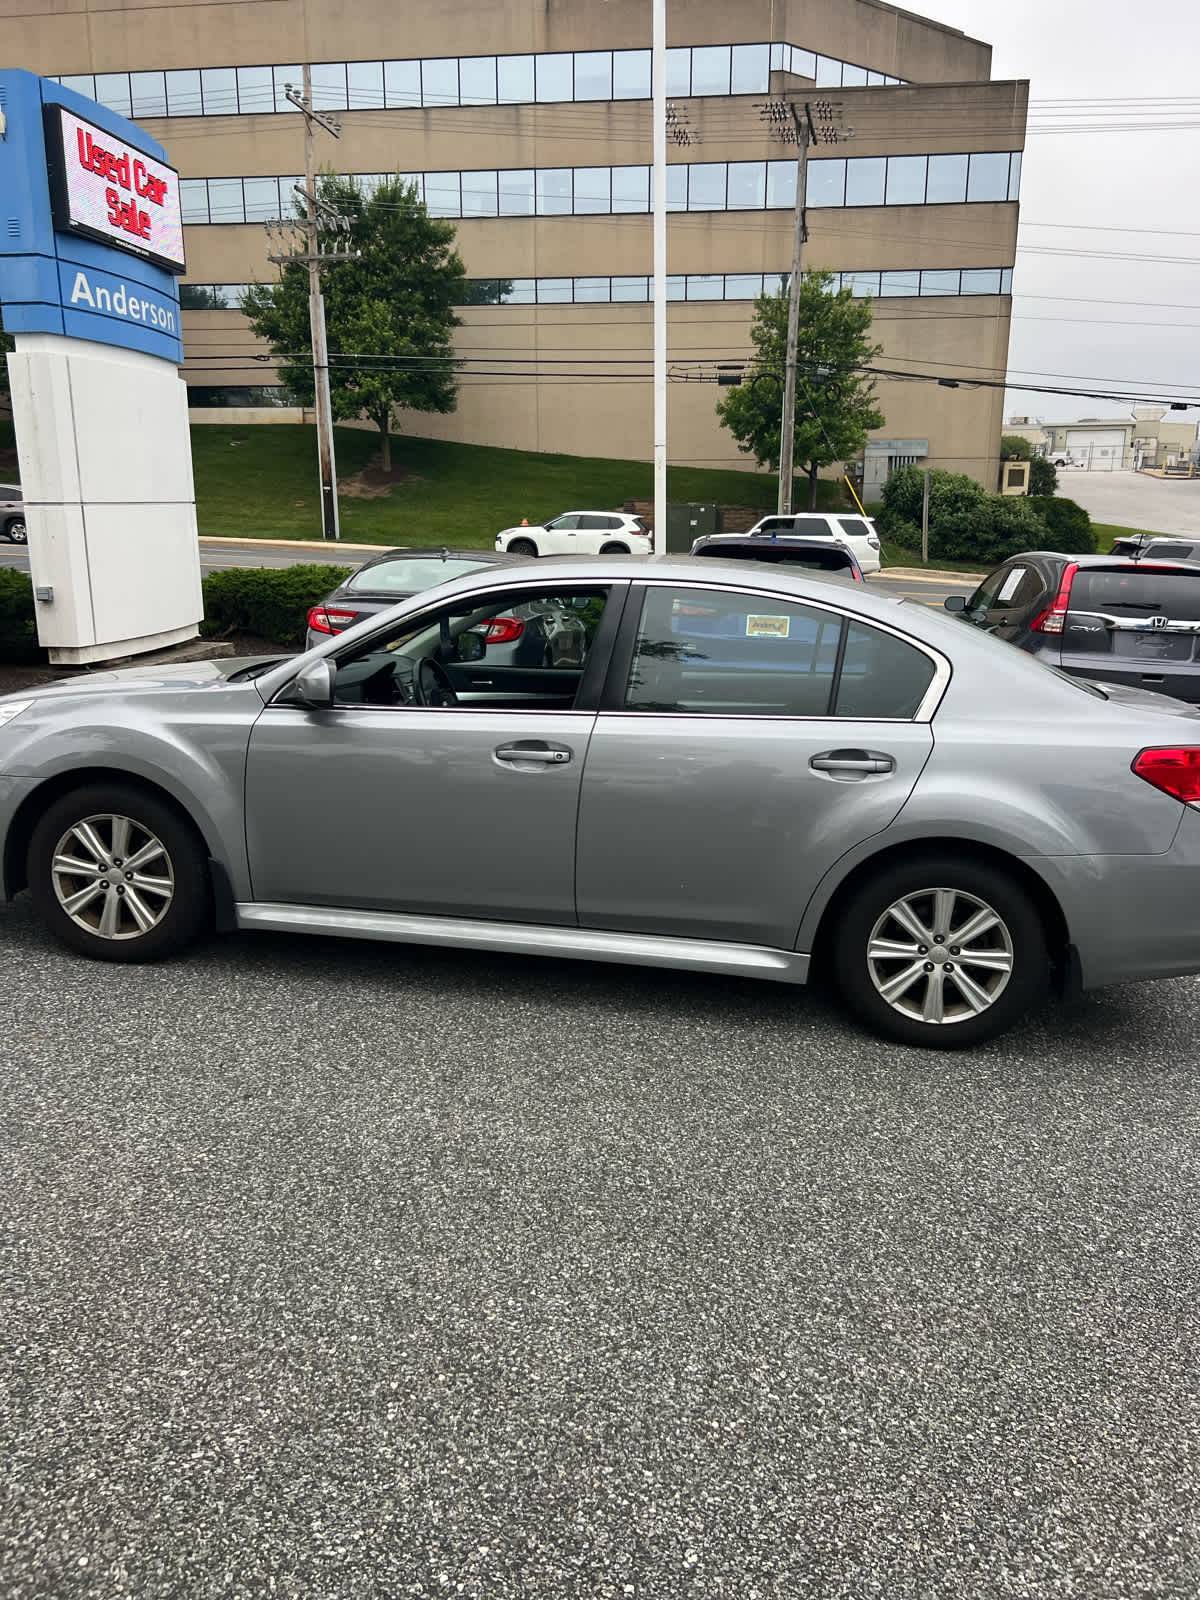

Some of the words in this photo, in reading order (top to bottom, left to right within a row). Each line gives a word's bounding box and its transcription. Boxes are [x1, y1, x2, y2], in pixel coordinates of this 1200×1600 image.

[77, 127, 131, 191] Used
[133, 158, 168, 207] Car
[105, 187, 152, 241] Sale
[70, 271, 176, 332] Anderson
